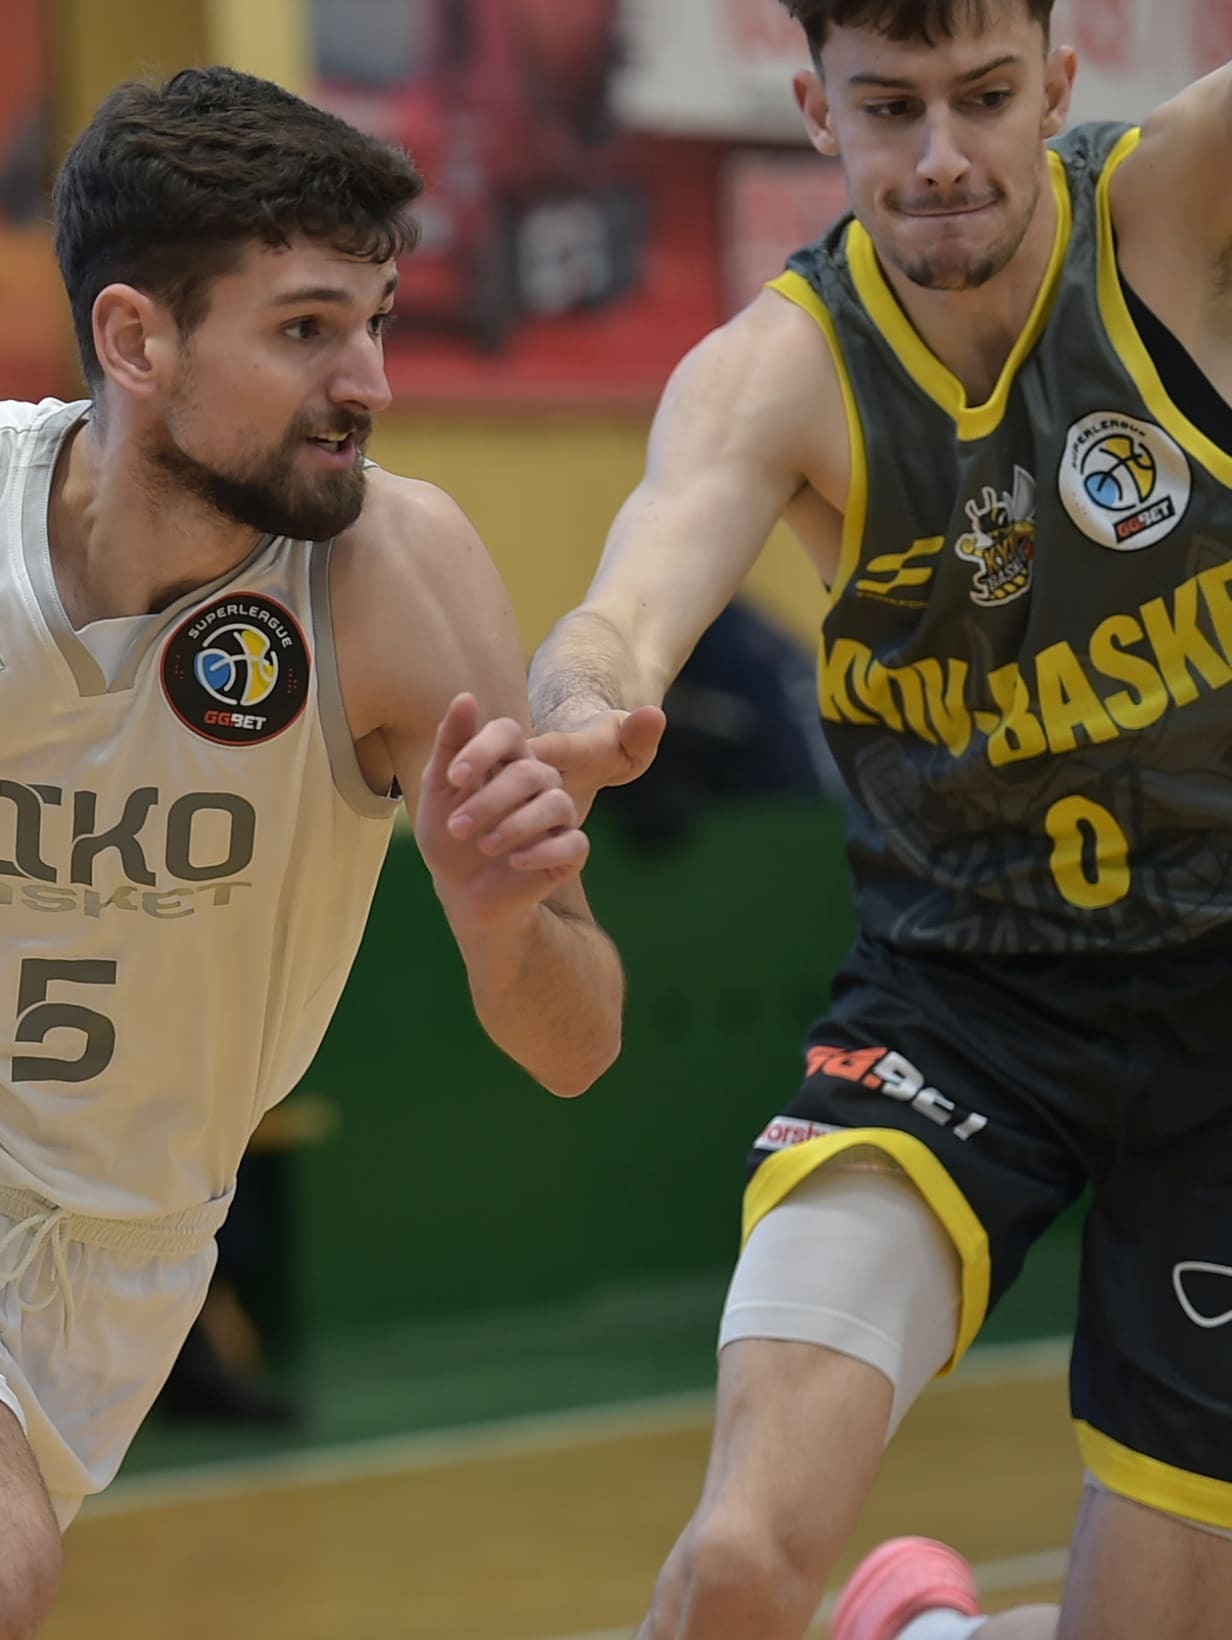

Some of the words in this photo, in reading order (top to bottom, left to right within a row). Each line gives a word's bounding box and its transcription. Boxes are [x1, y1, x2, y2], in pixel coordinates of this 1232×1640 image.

[188, 603, 293, 649] SUPERLEAGUE
[1045, 795, 1131, 910] 0
[11, 957, 117, 1083] 5
